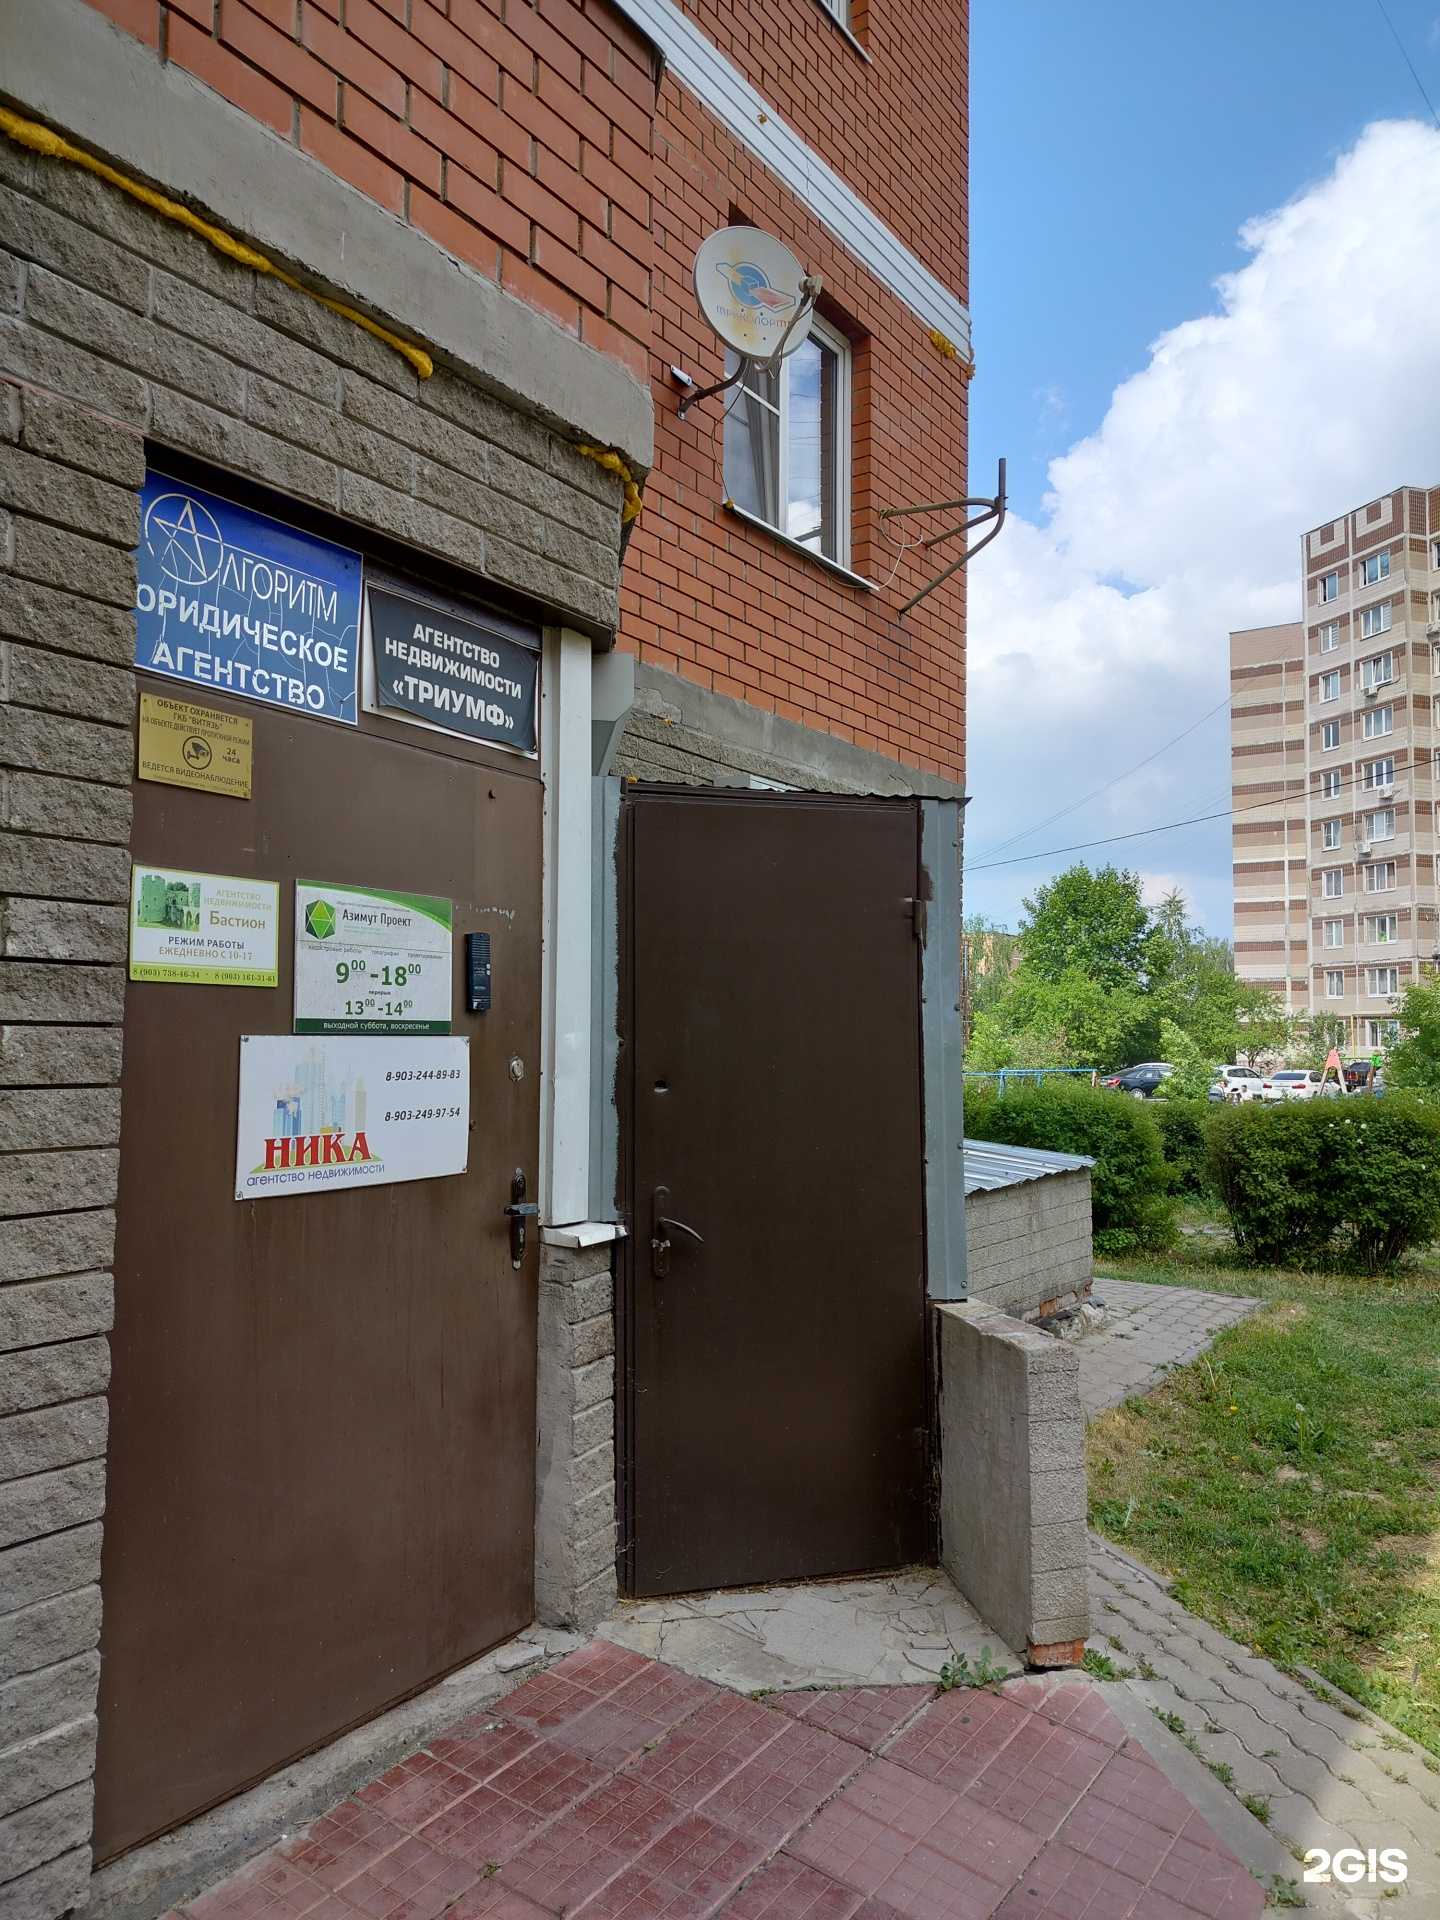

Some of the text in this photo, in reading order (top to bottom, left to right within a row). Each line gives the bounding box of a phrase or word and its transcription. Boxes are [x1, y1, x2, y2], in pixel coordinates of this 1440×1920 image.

[413, 623, 500, 668] АГЕНТСТВО
[152, 641, 325, 709] АГЕНТСТВО
[385, 637, 522, 699] НЕДВИЖИМОСТИ
[157, 699, 238, 725] ОБЪЕКТ ОХРАНЯЕТСЯ
[392, 675, 514, 729] «ТРИУМФ»
[226, 747, 236, 755] 24
[142, 761, 174, 774] ВЕДЕТСЯ
[175, 767, 249, 788] ВИДЕОНАБЛЮДЕНИЕ
[209, 910, 266, 929] Бастион
[342, 909, 412, 928] Азимут Проект
[168, 936, 244, 949] РЕЖИМ РАБОТЫ
[159, 947, 219, 958] ЕЖЕДНЕВНО
[229, 951, 253, 960] 10-17
[323, 1021, 430, 1031] выходной суббота, воскресенье
[385, 1069, 461, 1082] 8-903-244-89-83
[384, 1107, 460, 1122] 8-903-249-97-54
[264, 1132, 372, 1170] НИКА
[246, 1164, 385, 1187] агентство недвижимости
